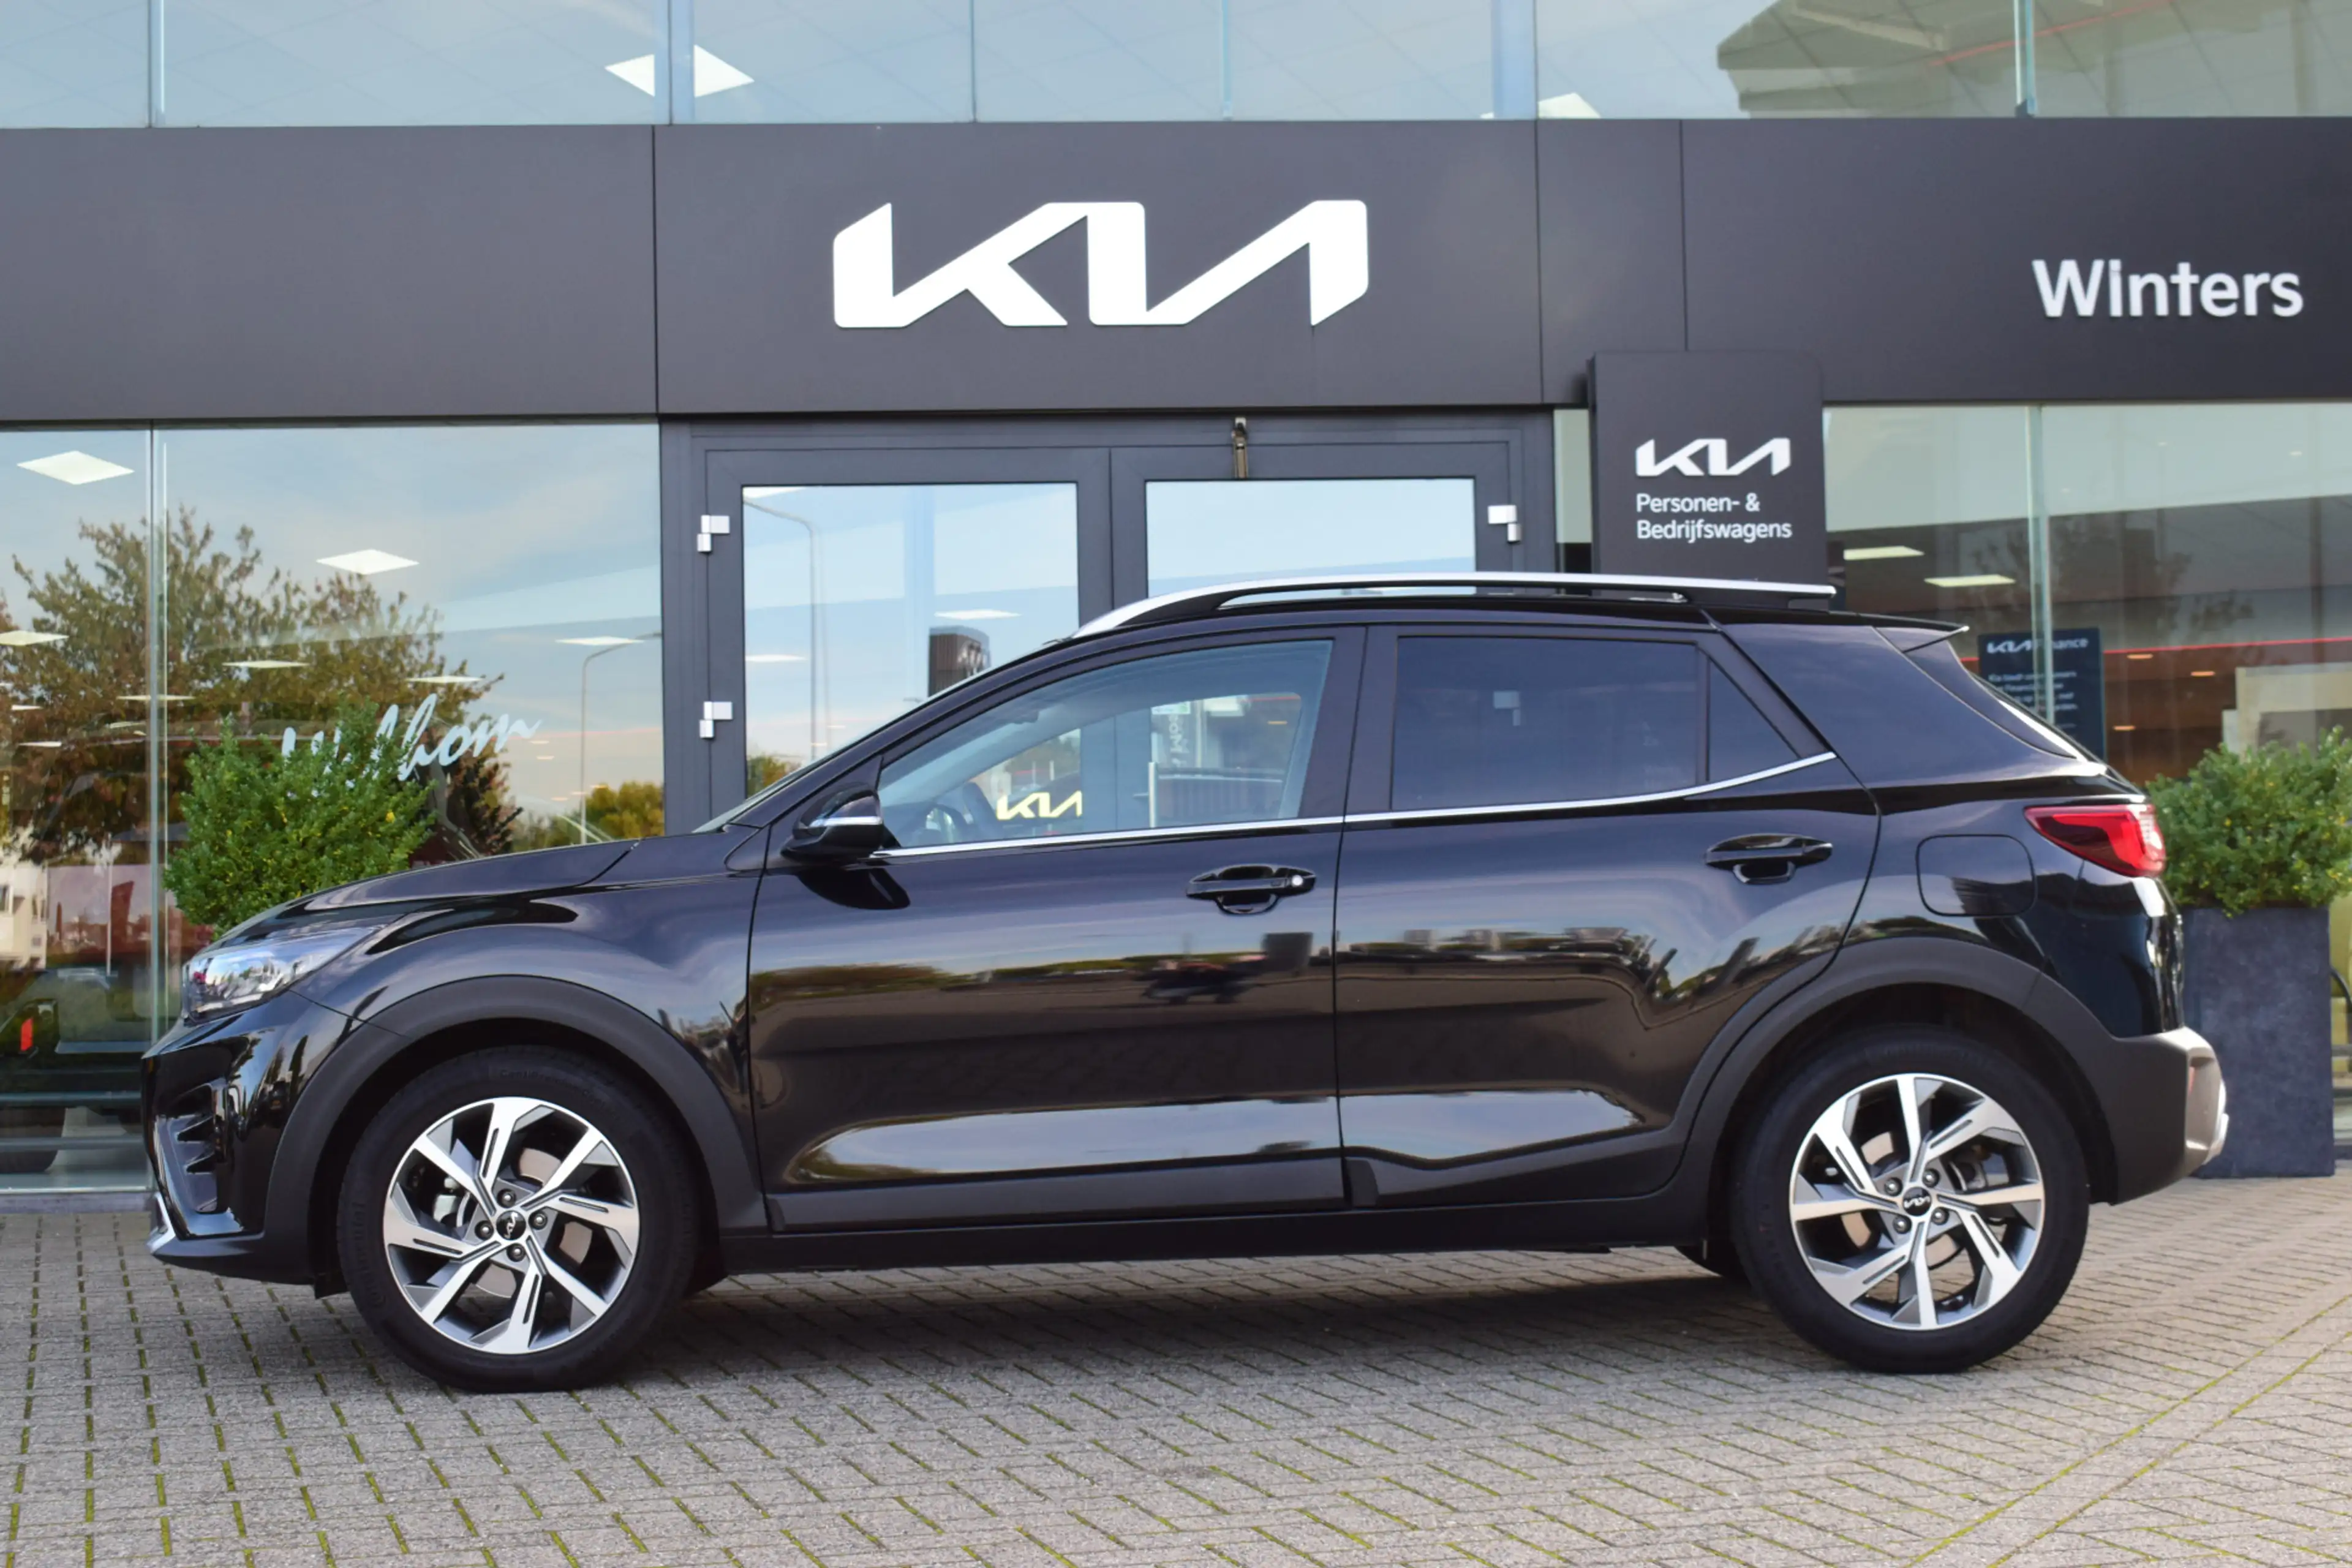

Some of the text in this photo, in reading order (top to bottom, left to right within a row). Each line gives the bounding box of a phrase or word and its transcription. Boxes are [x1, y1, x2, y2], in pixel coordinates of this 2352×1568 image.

[834, 200, 1369, 328] KIA
[2032, 259, 2304, 317] Winters
[1636, 437, 1791, 477] KIA
[1637, 492, 1760, 513] Personen- &
[1637, 519, 1793, 543] Bedrijfswagens
[997, 790, 1083, 820] KIA
